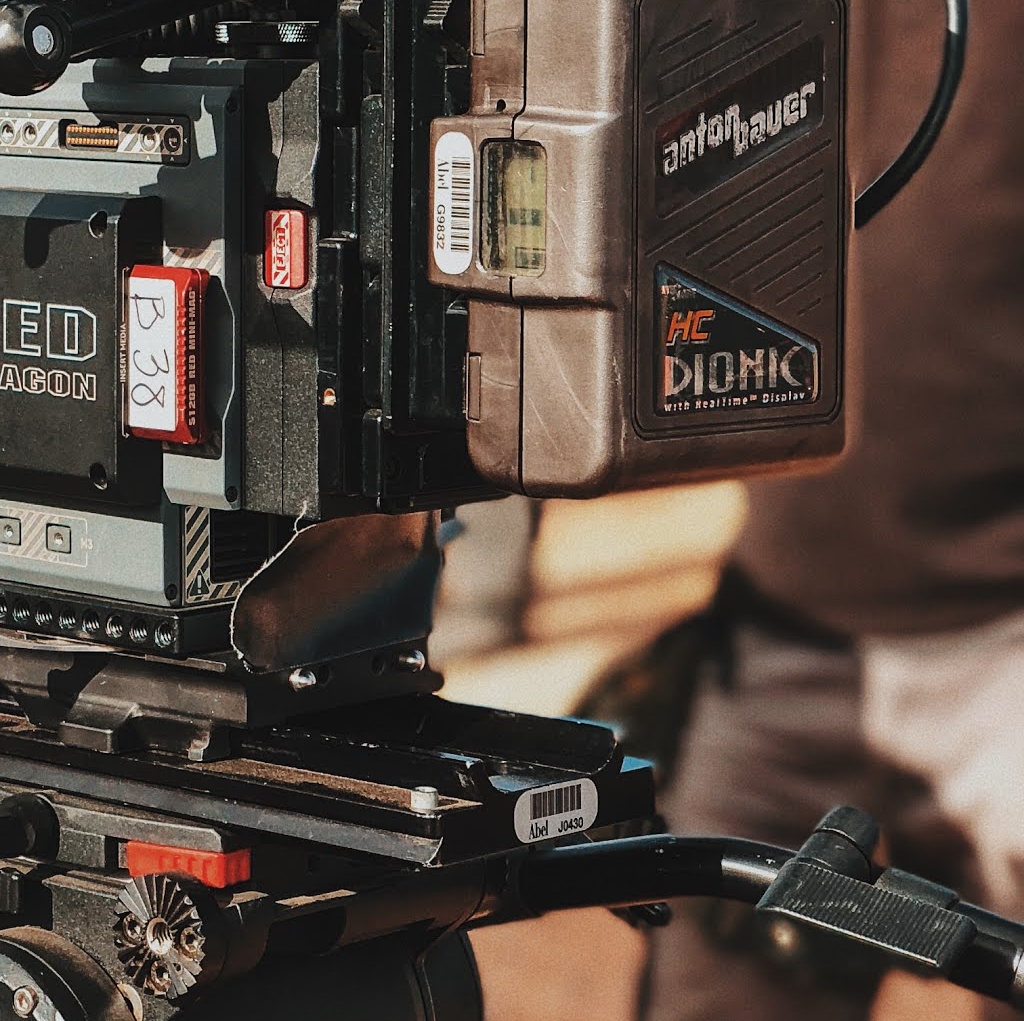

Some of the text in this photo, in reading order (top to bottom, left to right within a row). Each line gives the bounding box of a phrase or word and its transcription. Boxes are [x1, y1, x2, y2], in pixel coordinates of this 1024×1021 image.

[437, 204, 446, 250] G9832
[276, 227, 286, 271] EJECT
[130, 293, 166, 330] B
[666, 310, 715, 346] HC
[188, 354, 196, 378] RED
[665, 346, 804, 396] DIONIC
[80, 538, 93, 550] M3
[529, 817, 584, 839] Abel J0430
